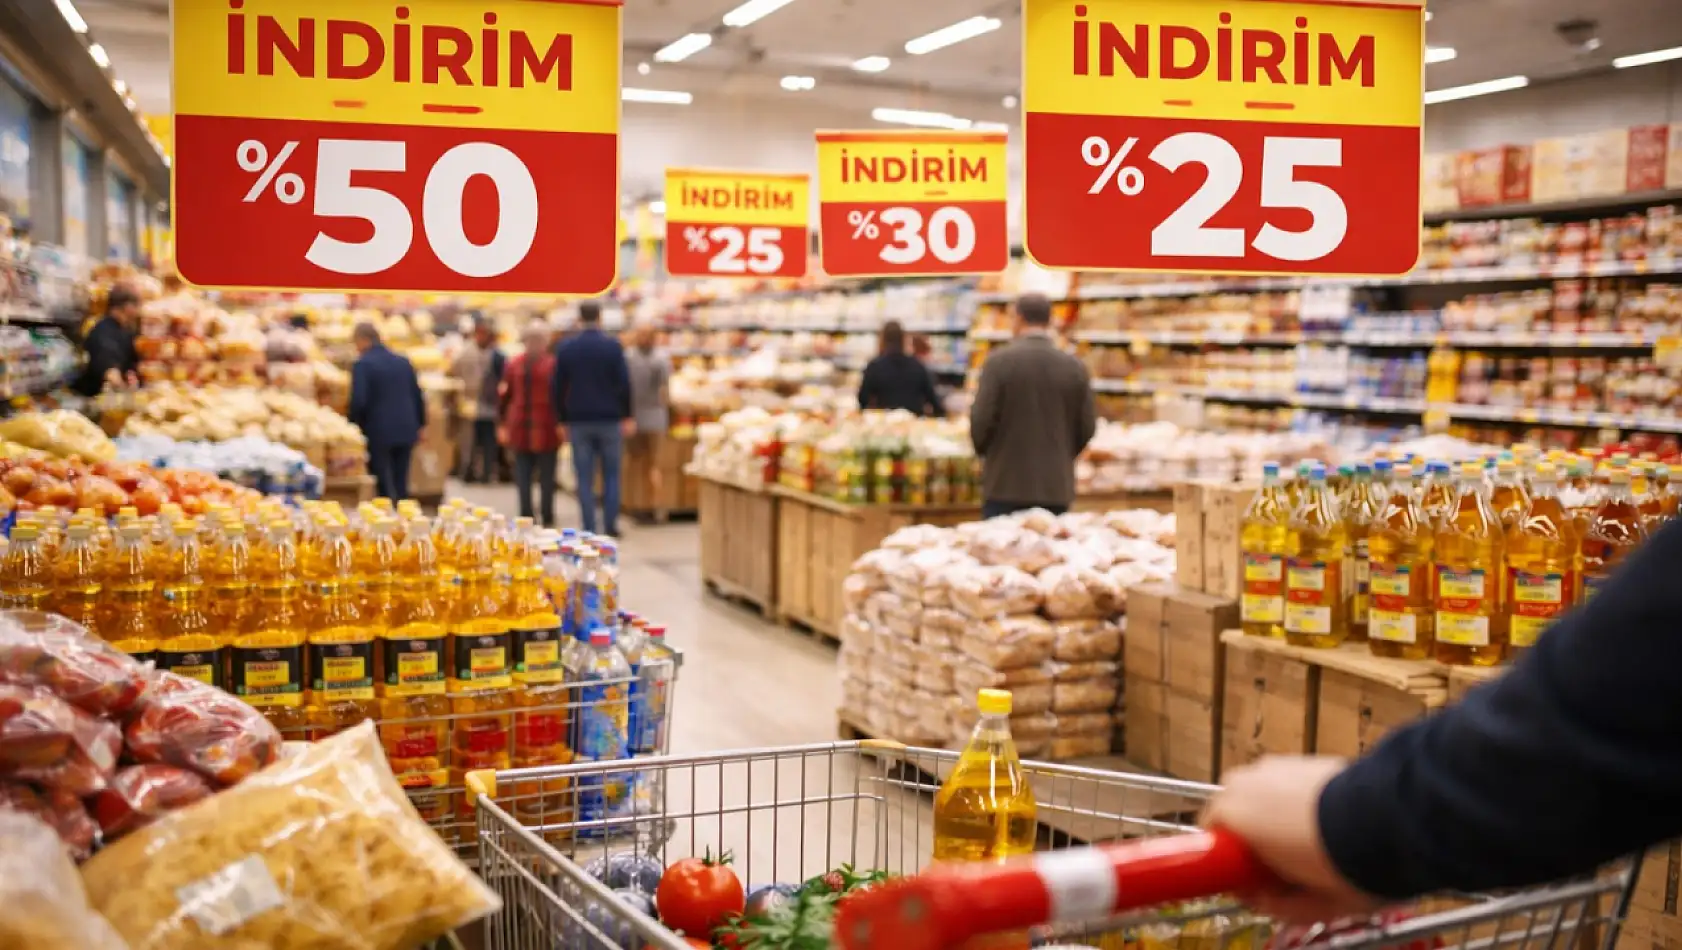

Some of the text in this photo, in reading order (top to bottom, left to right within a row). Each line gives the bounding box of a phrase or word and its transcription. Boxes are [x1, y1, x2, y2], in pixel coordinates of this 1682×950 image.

[227, 0, 573, 91] İNDİRİM
[1073, 4, 1375, 88] İNDİRİM
[681, 181, 794, 211] İNDİRİM
[840, 148, 988, 183] İNDİRİM
[1080, 131, 1348, 261] %25
[235, 139, 539, 278] %50
[848, 206, 976, 264] %30
[683, 226, 784, 273] %25
